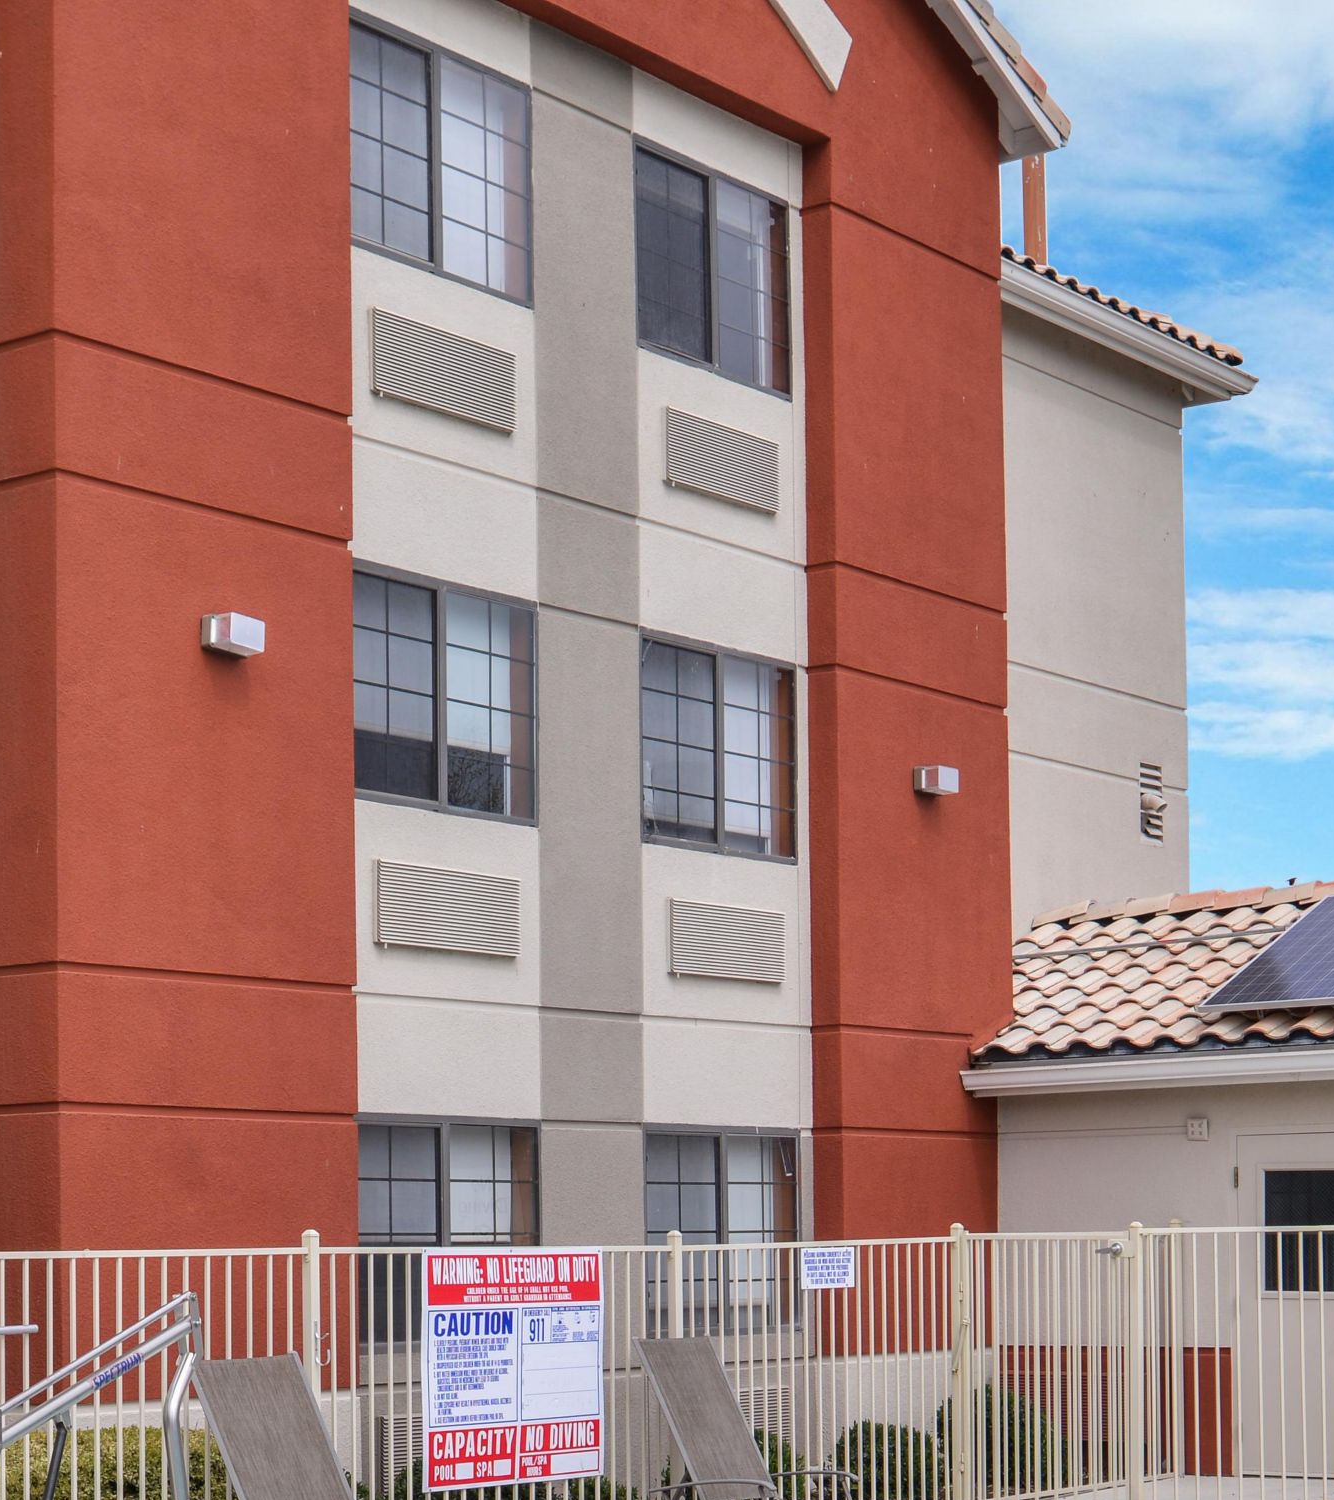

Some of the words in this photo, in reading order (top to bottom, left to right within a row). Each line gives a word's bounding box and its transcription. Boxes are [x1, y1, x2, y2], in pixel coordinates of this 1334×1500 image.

[432, 1257, 483, 1285] WARNING:
[487, 1257, 500, 1284] NO
[502, 1256, 555, 1283] LIFEGUARD
[558, 1256, 570, 1283] ON
[573, 1256, 596, 1282] DUTY
[434, 1311, 513, 1337] CAUTION
[530, 1318, 545, 1342] 911
[93, 1352, 143, 1389] SPECTRUM
[433, 1428, 515, 1460] CAPACITY
[526, 1425, 544, 1451] NO
[550, 1421, 595, 1450] DIVING
[434, 1464, 455, 1482] POOL
[476, 1462, 493, 1478] SPA
[522, 1455, 547, 1466] POOL/SPA
[527, 1466, 542, 1477] HOURS
